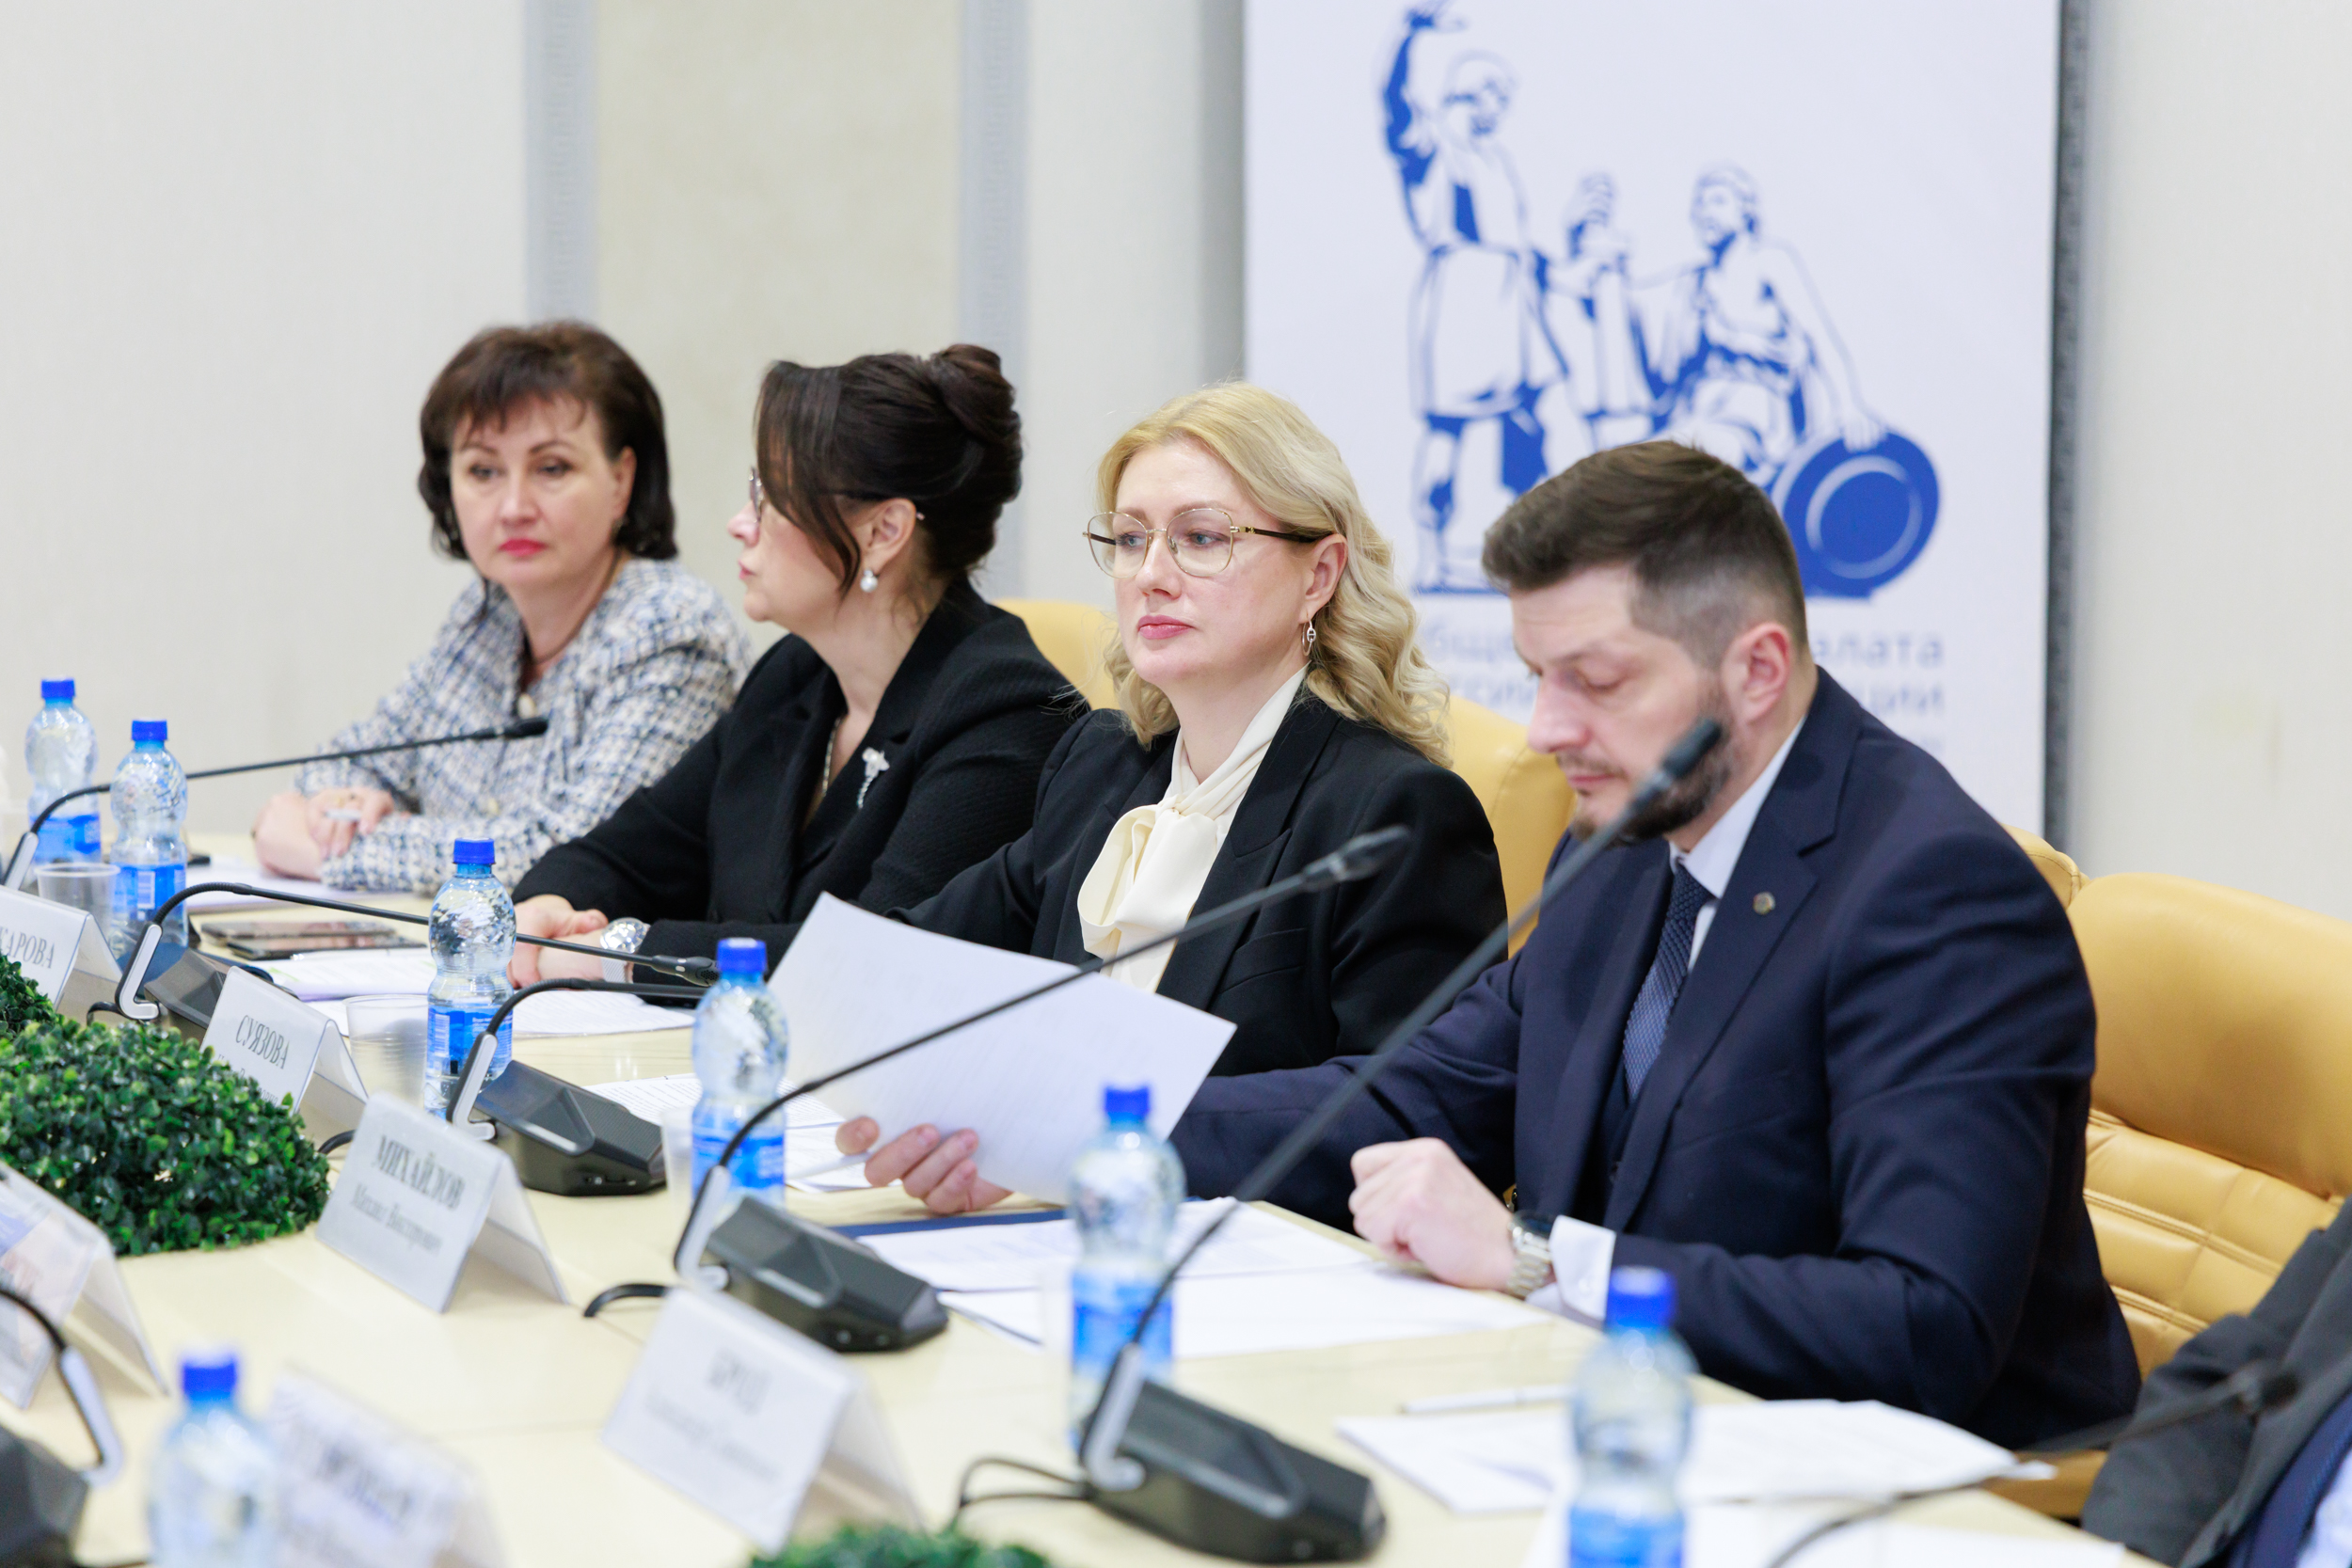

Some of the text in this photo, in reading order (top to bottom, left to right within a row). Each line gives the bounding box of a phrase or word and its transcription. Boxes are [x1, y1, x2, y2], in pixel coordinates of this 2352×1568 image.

[1811, 631, 1944, 667] алата
[235, 1014, 290, 1070] СУЯЗОВА
[371, 1133, 467, 1211] МИХАЙЛОВ
